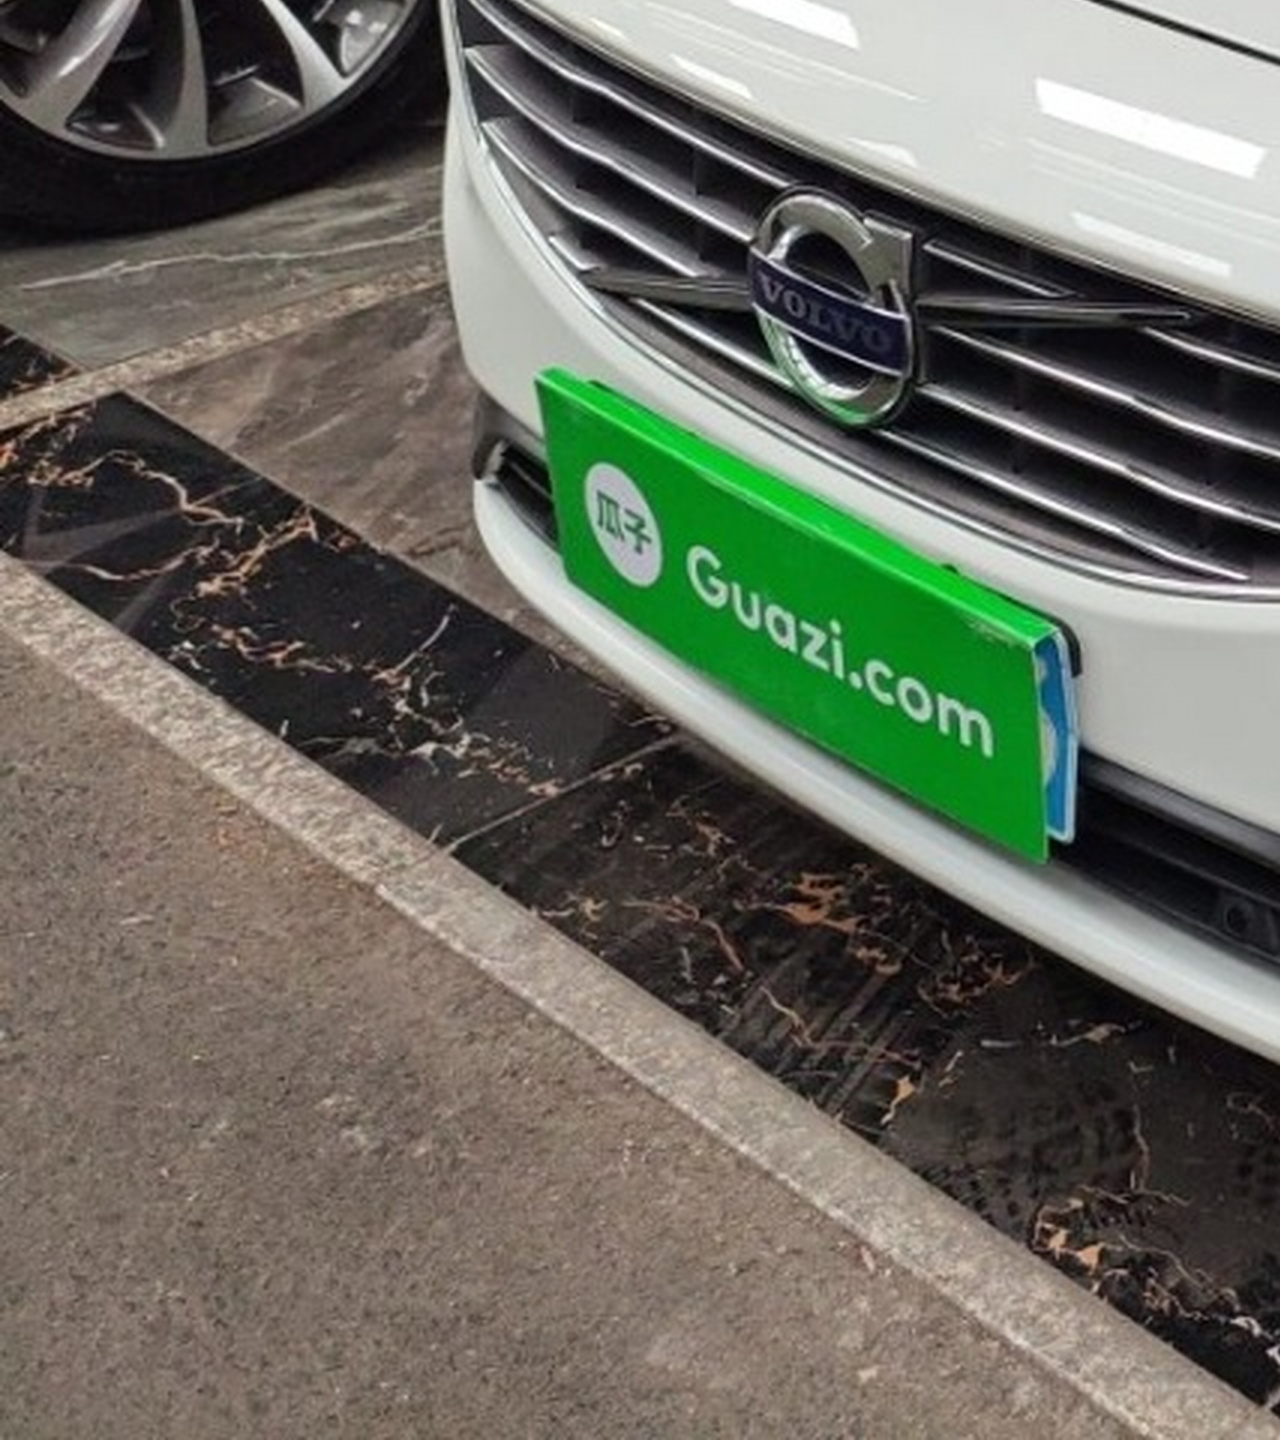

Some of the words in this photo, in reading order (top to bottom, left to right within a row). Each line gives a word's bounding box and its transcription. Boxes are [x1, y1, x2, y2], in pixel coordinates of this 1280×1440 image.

[757, 271, 892, 352] VOLVO
[595, 490, 654, 556] 瓜子
[685, 544, 995, 759] Guazi.com
